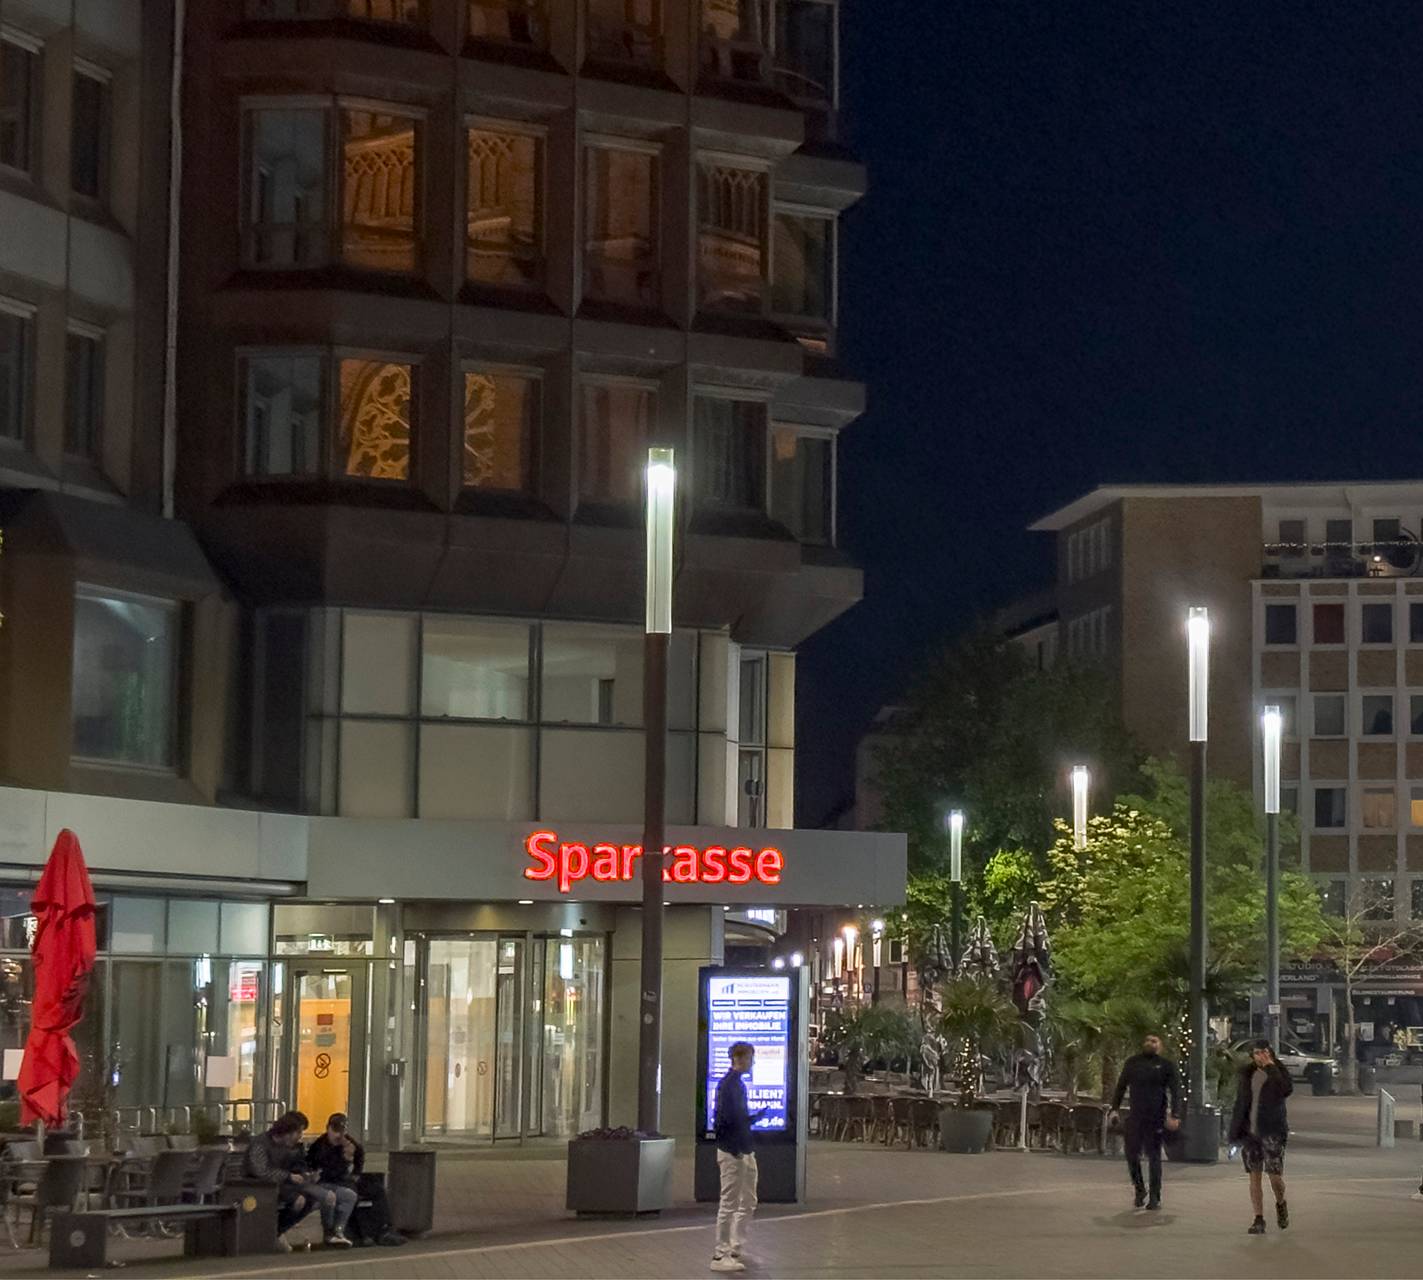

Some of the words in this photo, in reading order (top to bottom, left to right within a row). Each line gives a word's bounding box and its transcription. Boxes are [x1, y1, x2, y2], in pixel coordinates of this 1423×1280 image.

[712, 1011, 732, 1021] WIR
[733, 1011, 786, 1021] VERKAUFEN
[735, 1021, 782, 1031] IMMOBILIE
